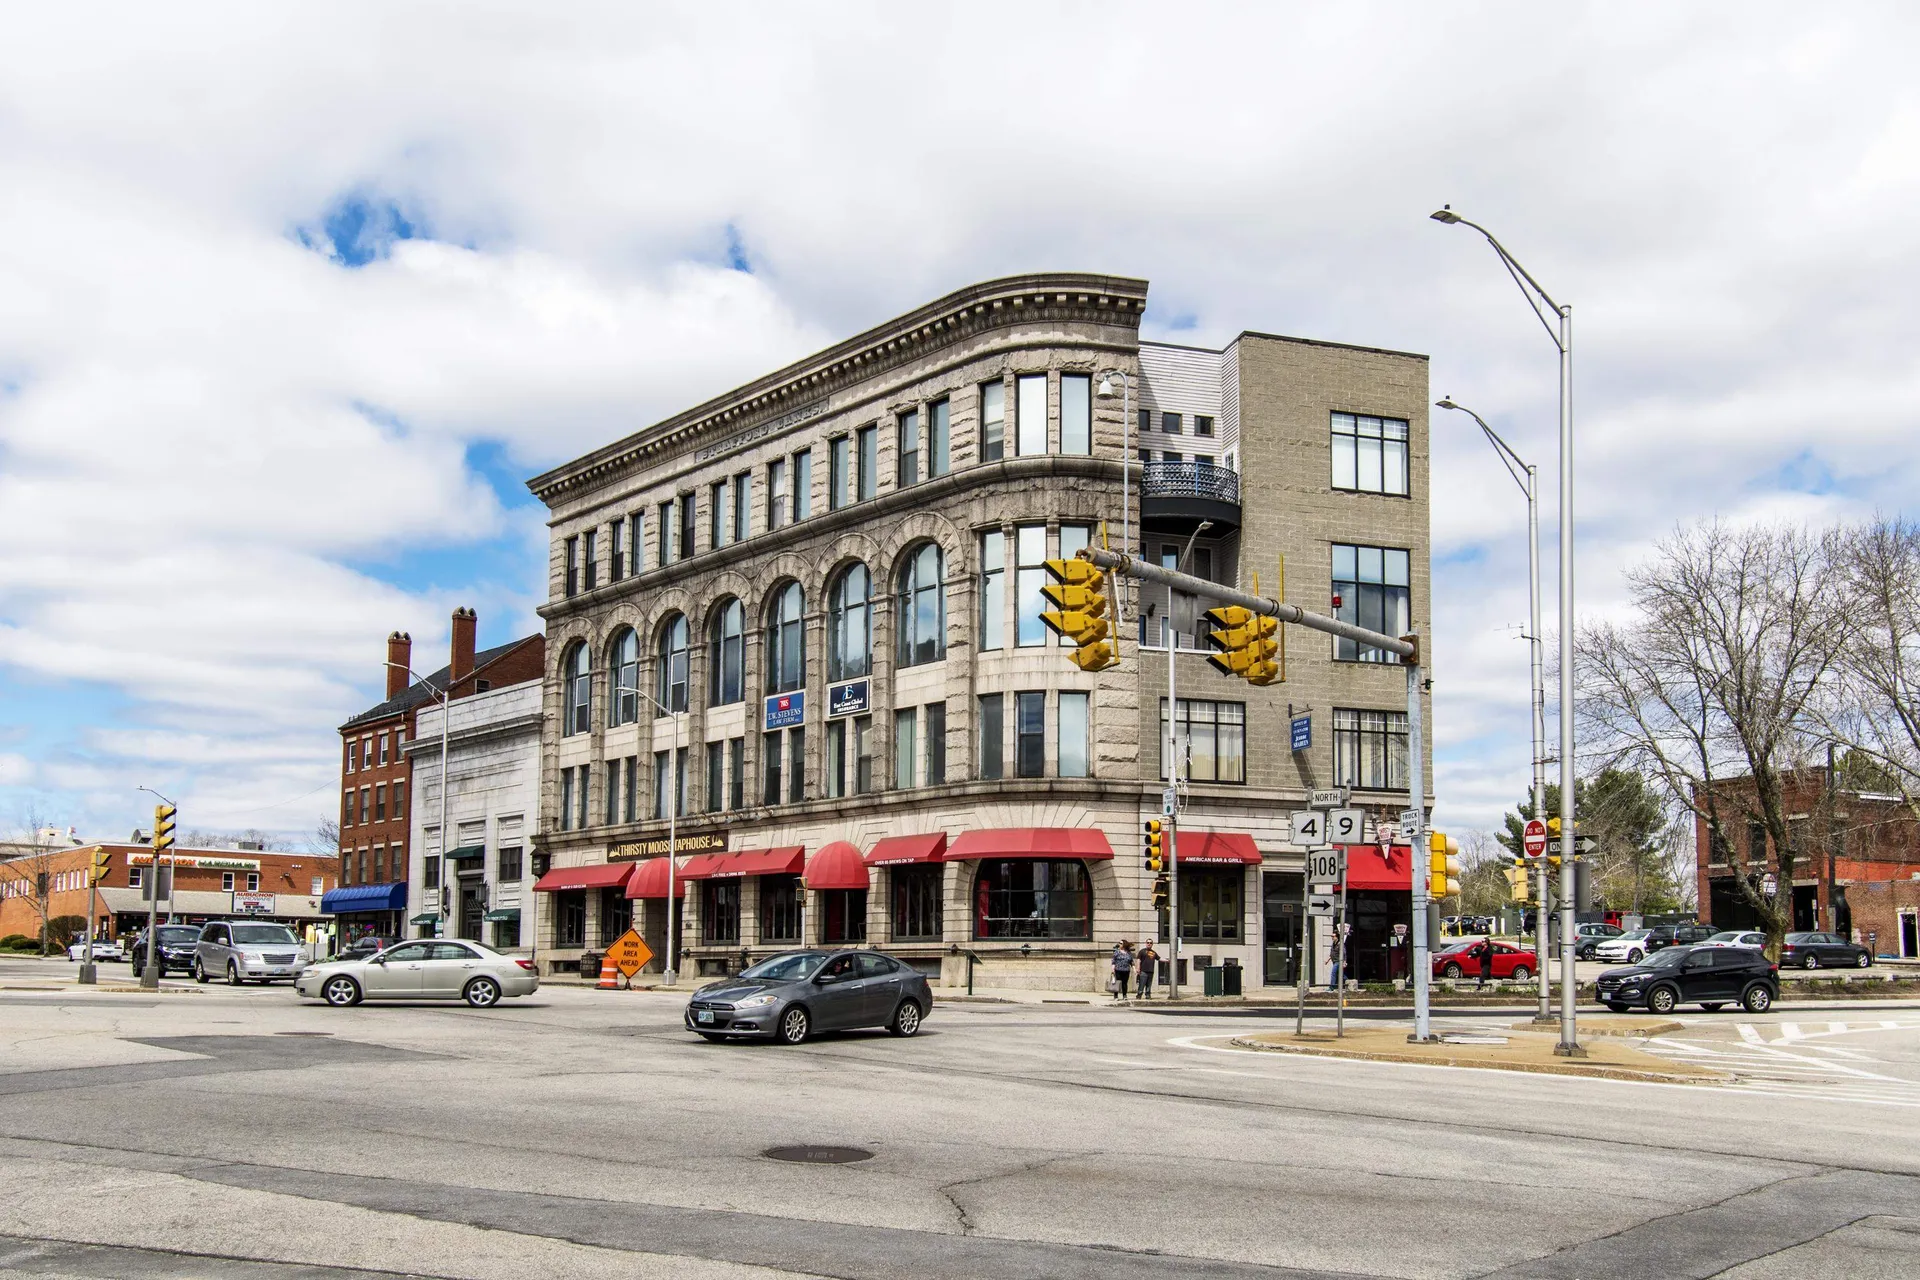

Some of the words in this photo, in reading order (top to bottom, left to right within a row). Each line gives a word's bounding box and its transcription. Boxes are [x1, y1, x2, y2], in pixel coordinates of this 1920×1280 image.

[777, 708, 802, 719] STEVENS
[1314, 793, 1338, 802] NORTH
[1402, 812, 1418, 820] TRUCK
[1300, 818, 1318, 837] 4
[1339, 817, 1353, 836] 9
[1402, 820, 1417, 828] ROUTE
[620, 842, 648, 857] THIRSTY
[648, 839, 671, 854] MOOSE
[674, 835, 710, 851] TAPHOUSE
[132, 855, 196, 866] AUBCON
[1312, 856, 1337, 876] 108
